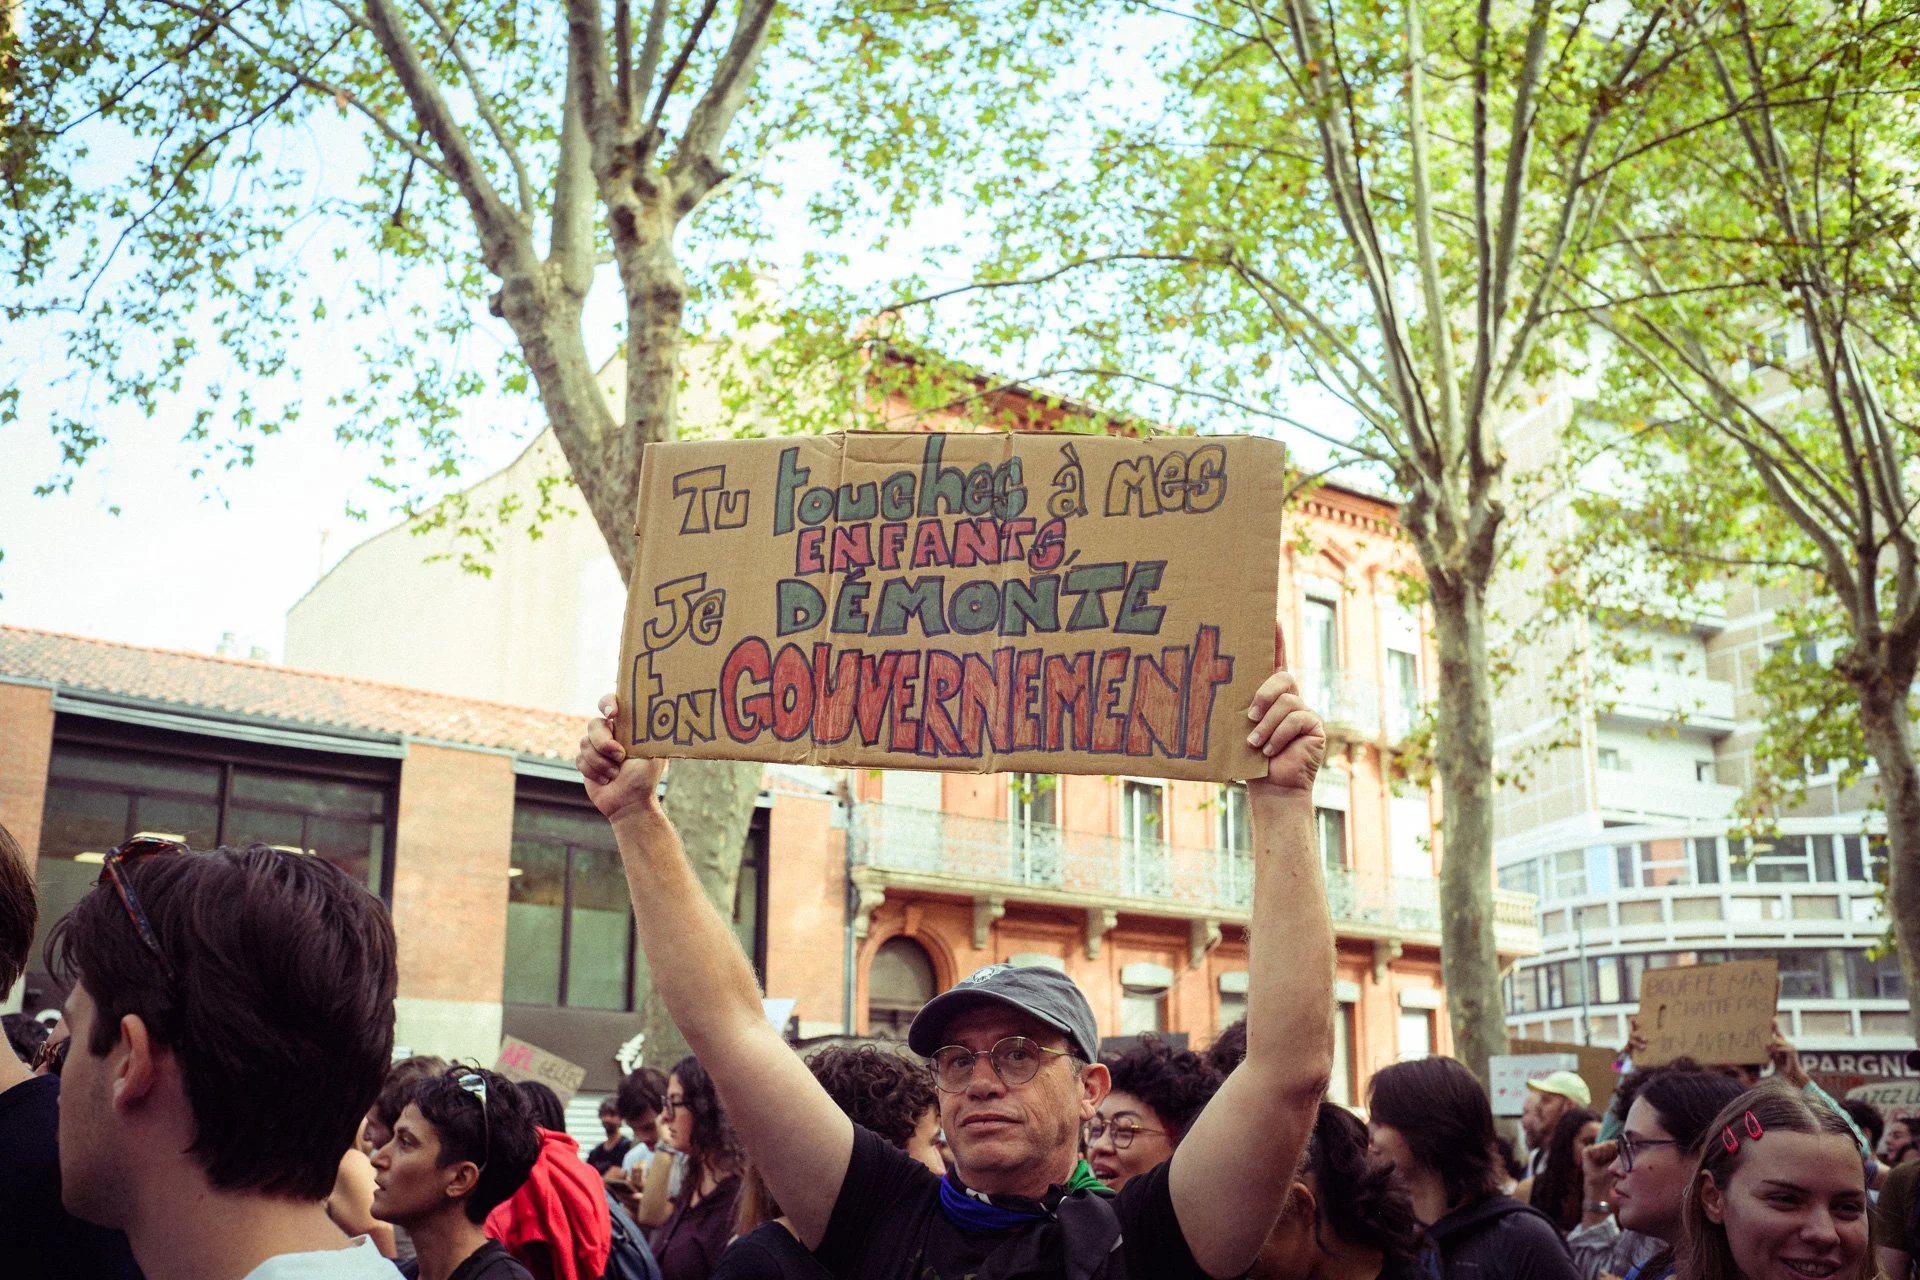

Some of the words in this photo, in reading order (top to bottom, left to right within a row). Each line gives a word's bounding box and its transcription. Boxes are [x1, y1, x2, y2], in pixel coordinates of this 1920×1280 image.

[672, 464, 750, 535] Tu
[773, 432, 1028, 536] touches
[1047, 441, 1088, 518] à
[794, 516, 1081, 576] ENFANTS,
[644, 570, 726, 651] Je
[776, 560, 1168, 637] DÉMONTE
